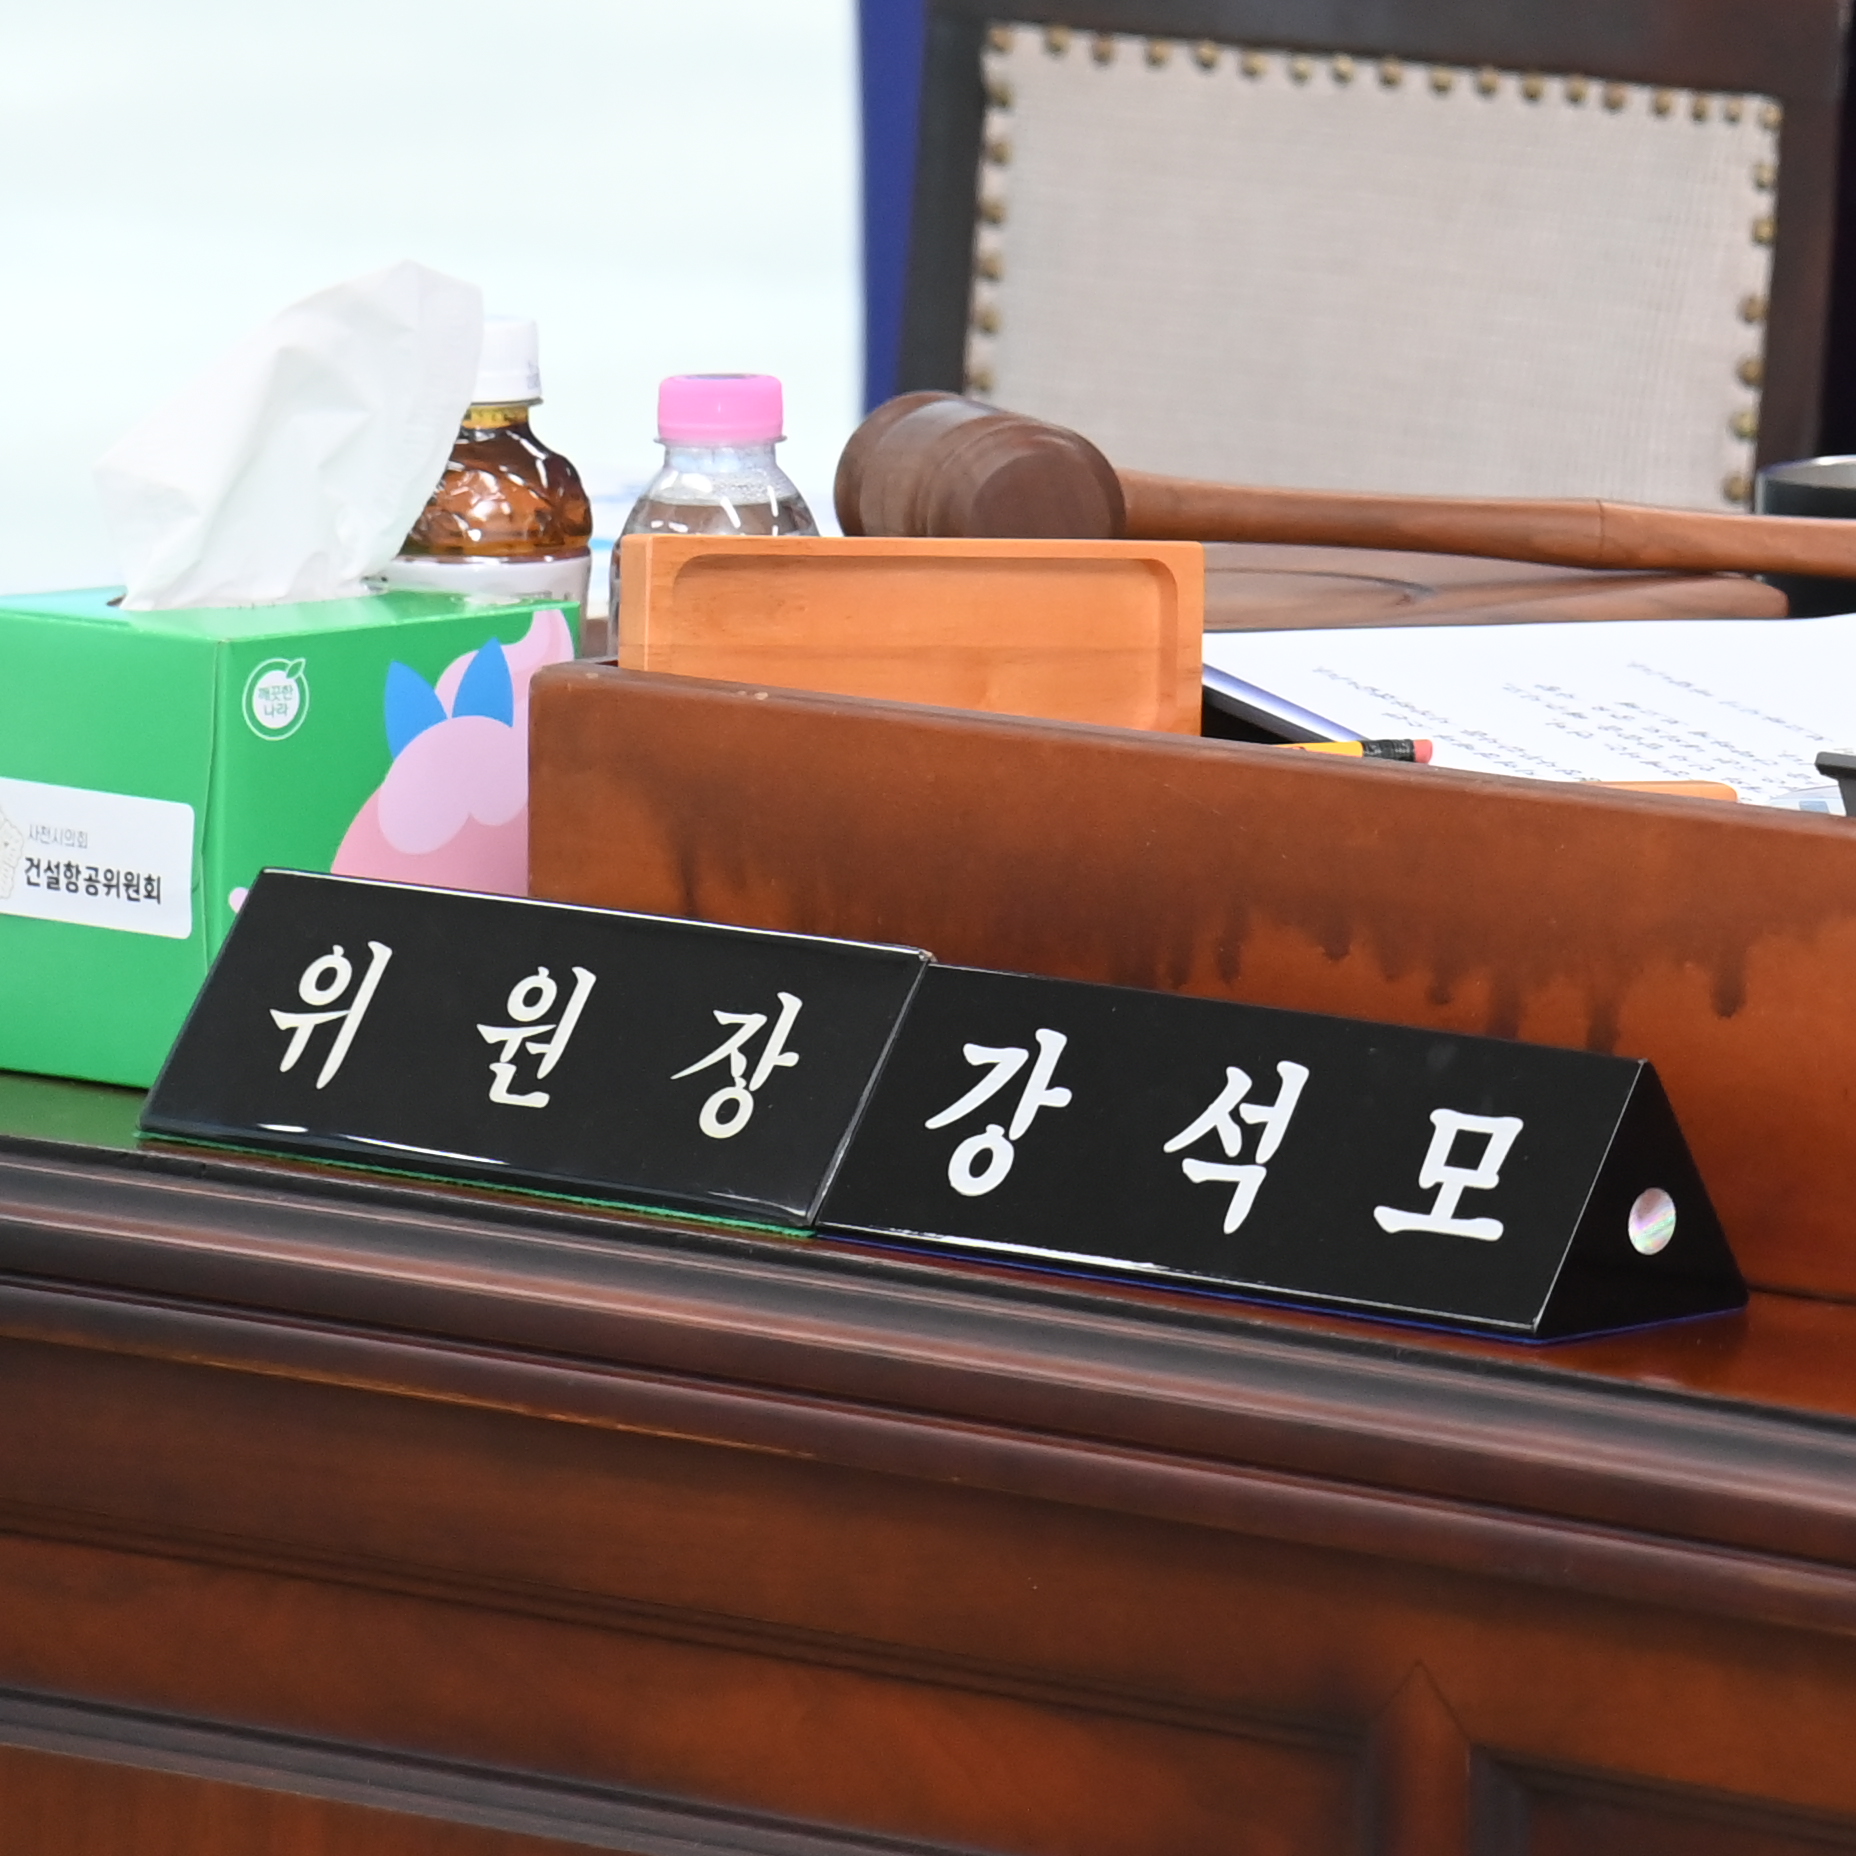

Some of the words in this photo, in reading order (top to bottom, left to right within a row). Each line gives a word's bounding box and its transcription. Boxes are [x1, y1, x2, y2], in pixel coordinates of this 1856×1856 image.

[264, 703, 288, 718] 나라
[28, 823, 89, 850] 사천시의회
[24, 856, 162, 906] 건설항공위원회
[269, 940, 804, 1140] 위원장
[924, 1028, 1525, 1242] 강석모
